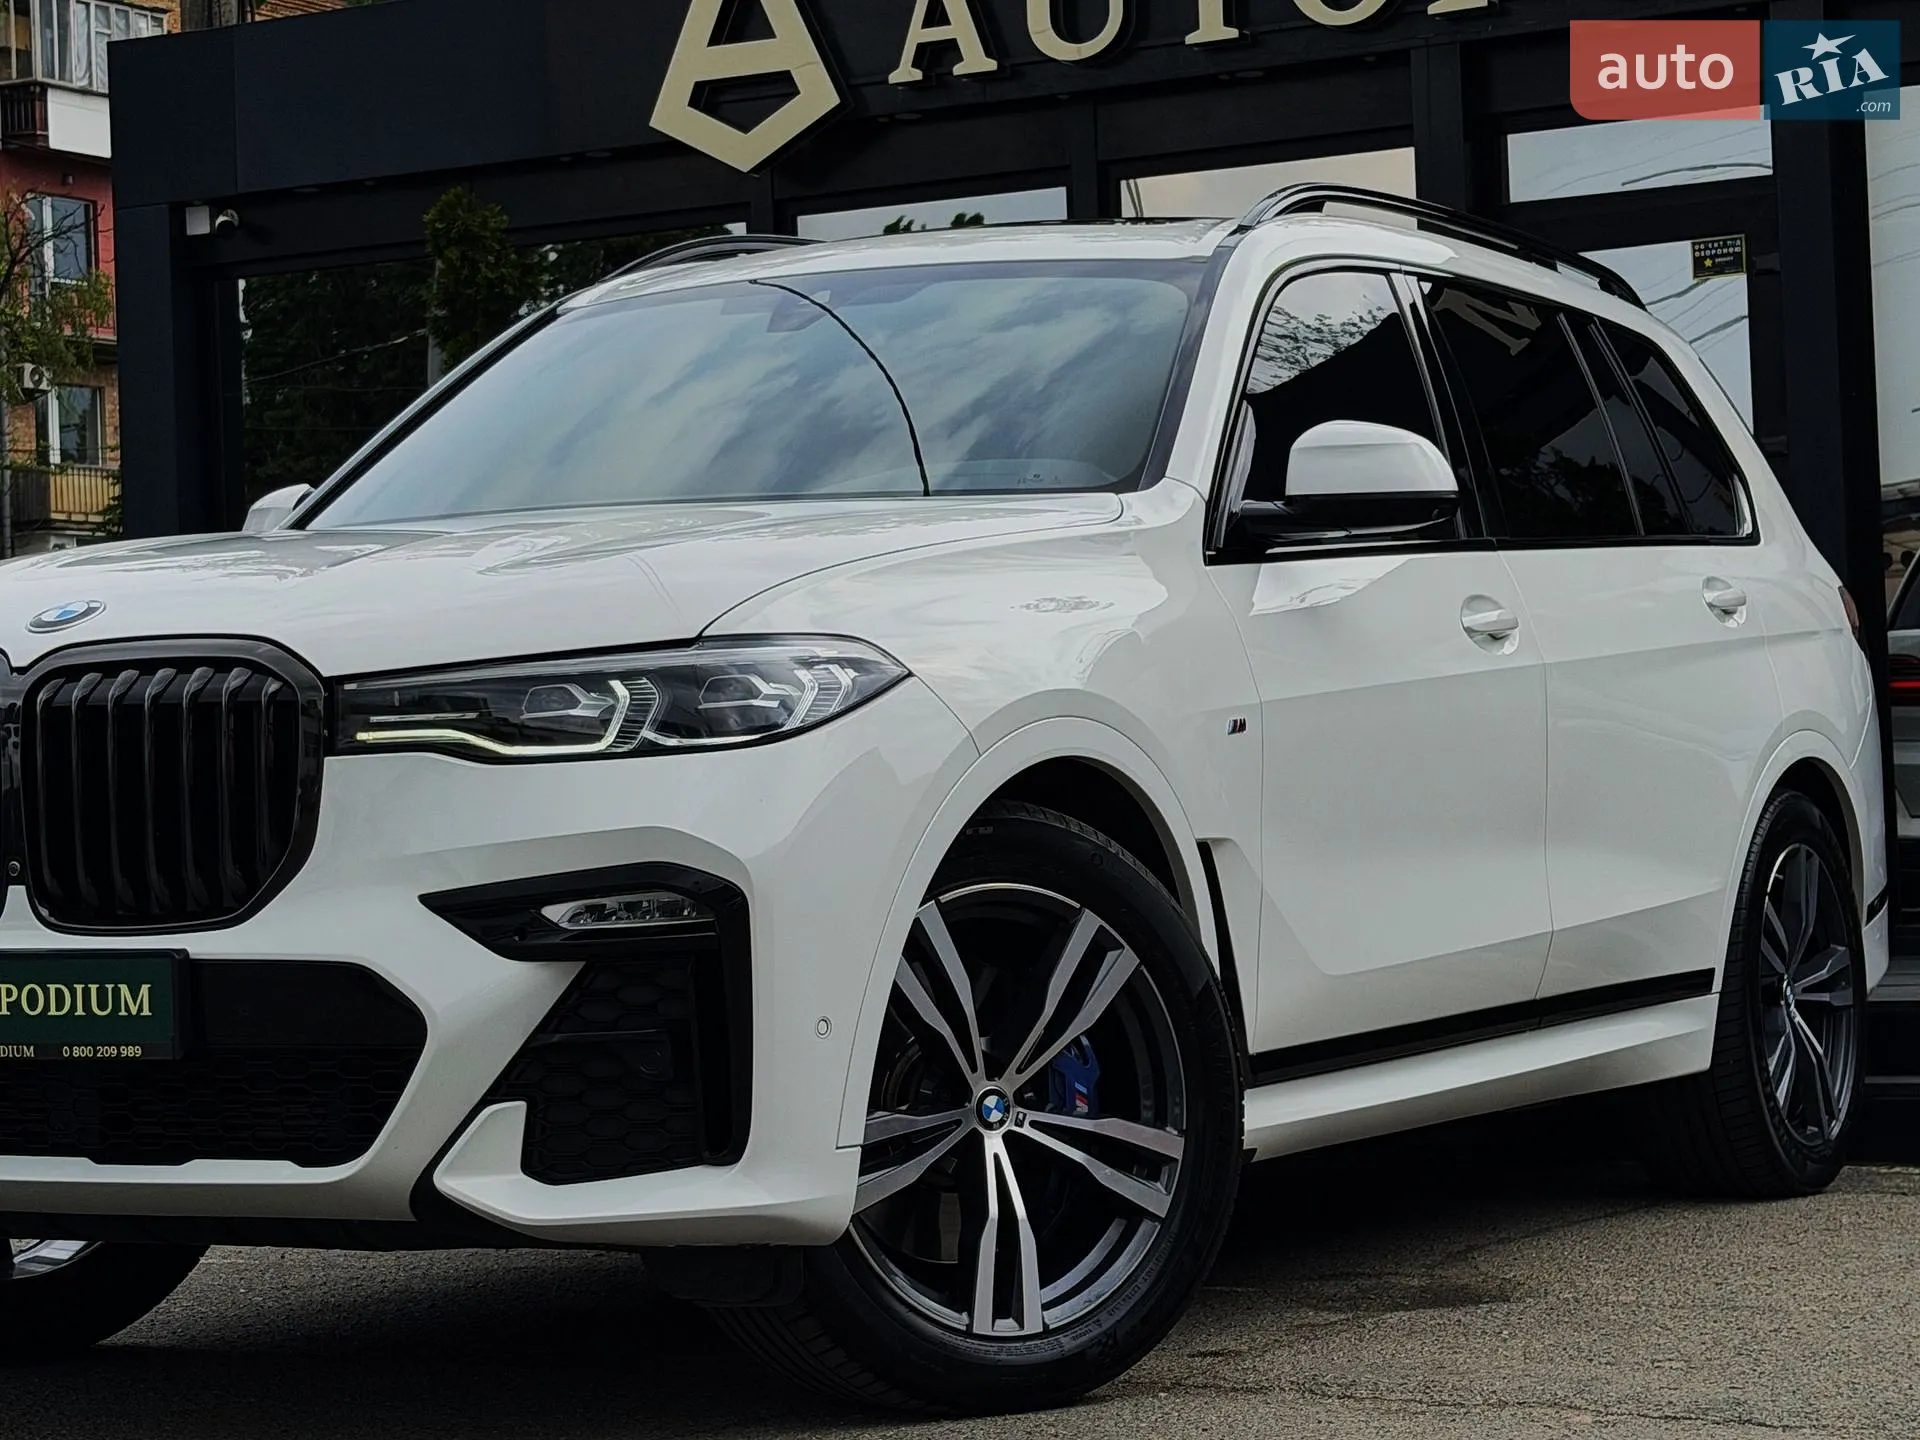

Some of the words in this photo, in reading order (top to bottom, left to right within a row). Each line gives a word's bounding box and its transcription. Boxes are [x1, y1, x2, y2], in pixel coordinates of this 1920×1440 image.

[0, 983, 152, 1016] PODIUM
[62, 1045, 70, 1058] 0
[72, 1045, 94, 1058] 800
[96, 1045, 118, 1058] 209
[120, 1045, 142, 1058] 989
